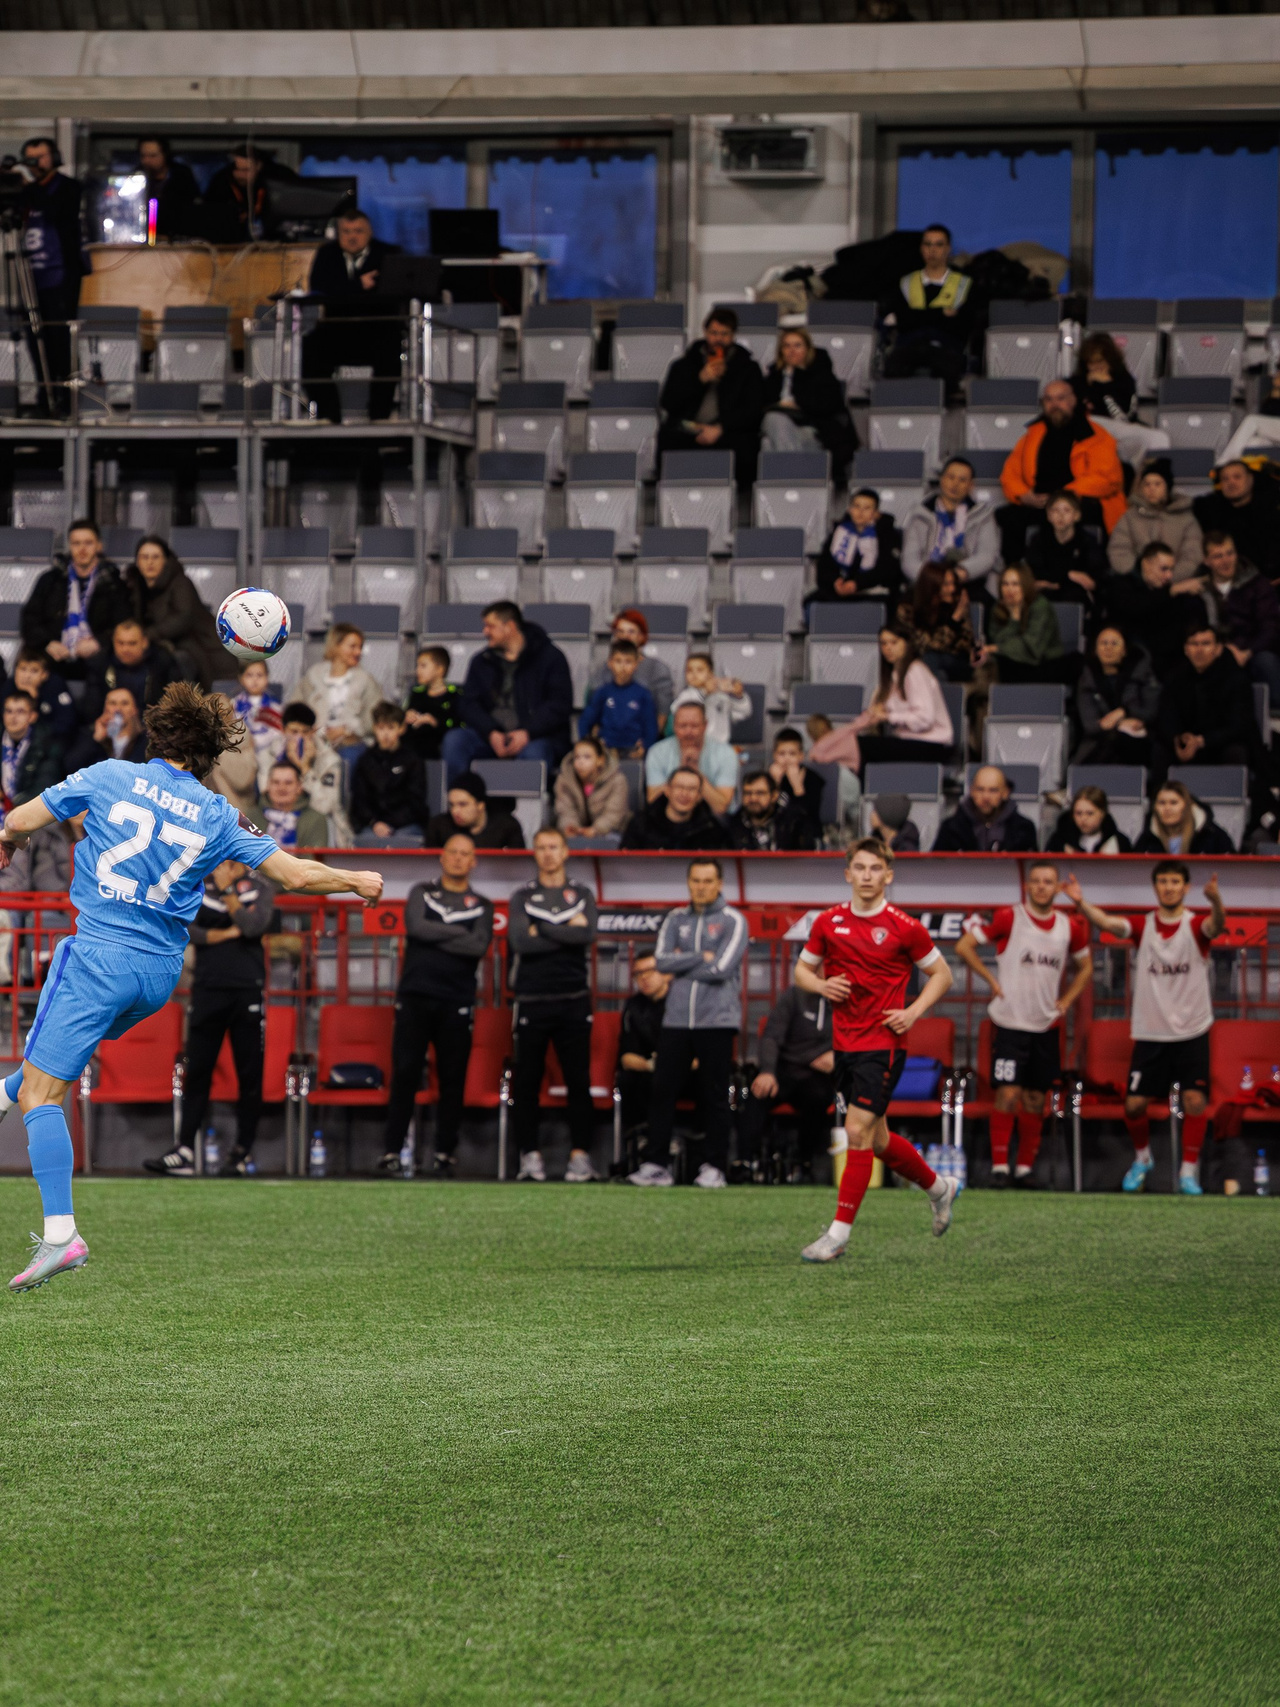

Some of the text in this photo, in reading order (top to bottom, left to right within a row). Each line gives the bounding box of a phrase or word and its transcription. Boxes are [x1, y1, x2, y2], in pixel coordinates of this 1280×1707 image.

[239, 602, 262, 629] DEMIX
[132, 777, 201, 823] БАВИН
[95, 800, 207, 905] 27
[597, 915, 662, 931] EMIX
